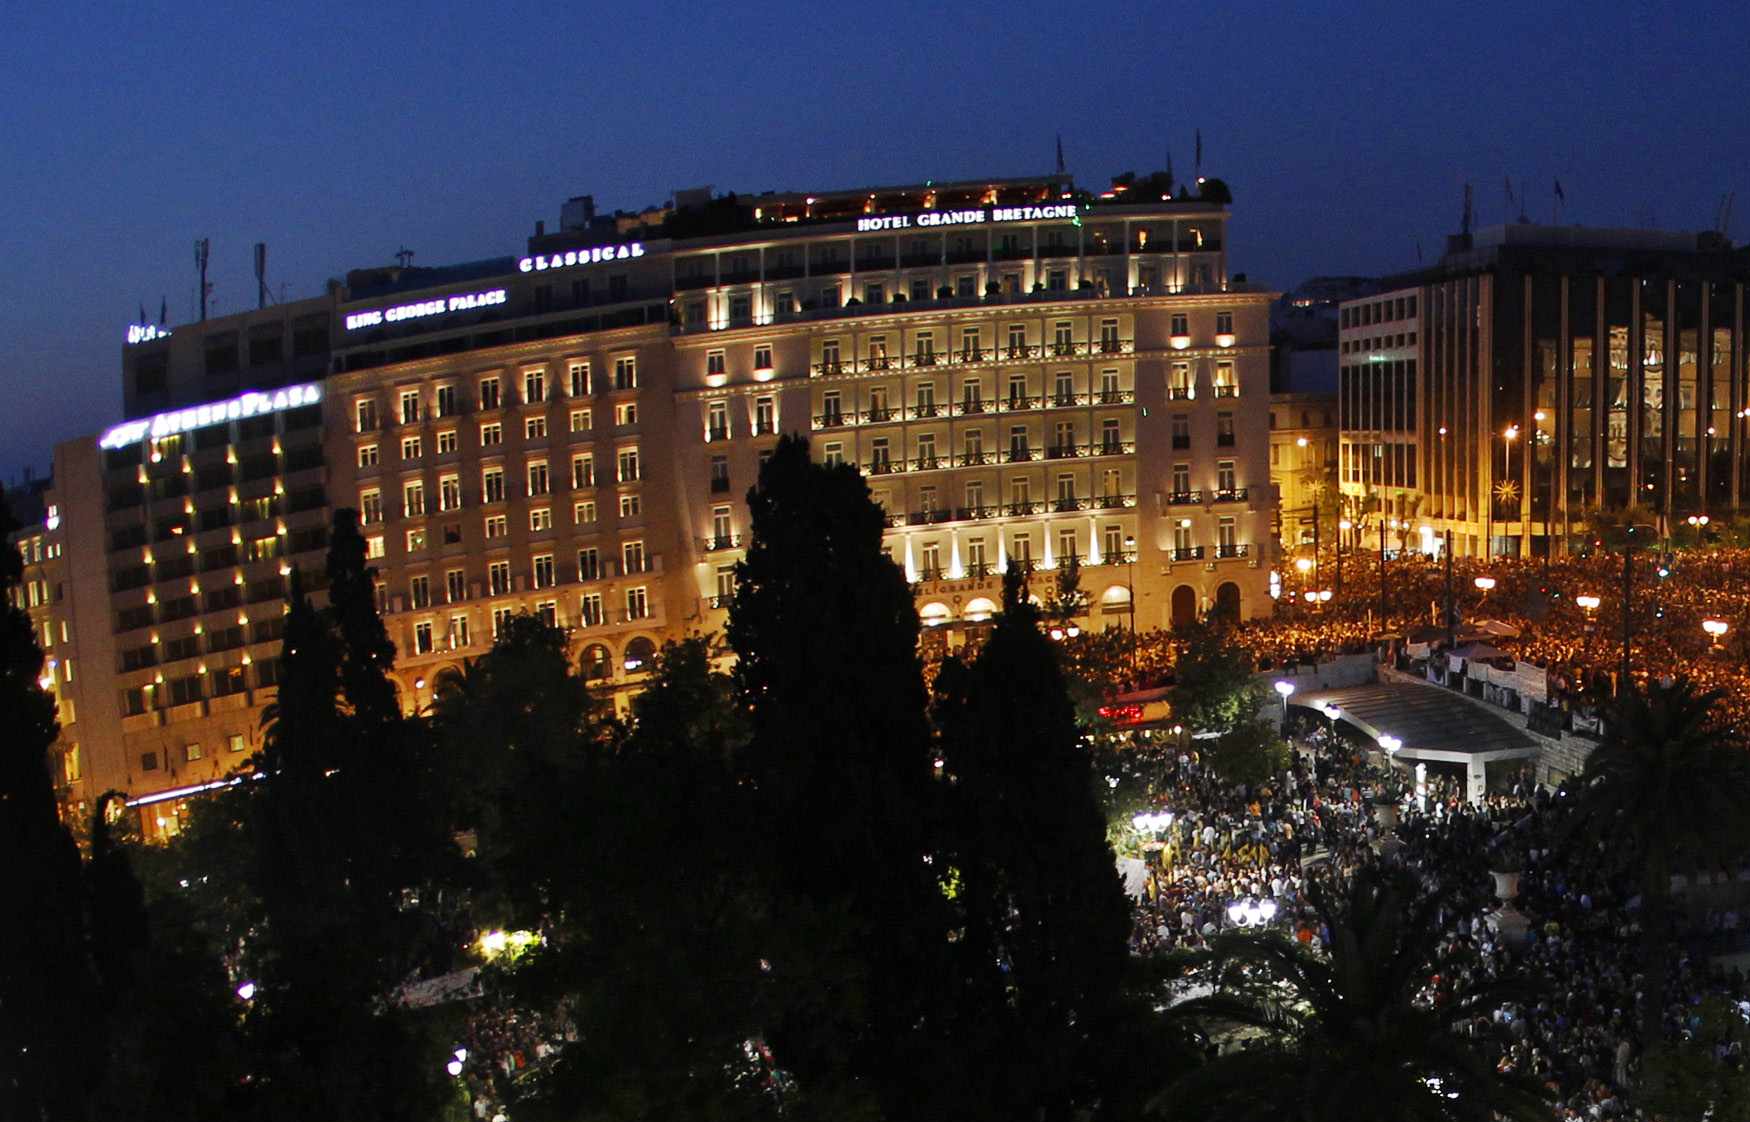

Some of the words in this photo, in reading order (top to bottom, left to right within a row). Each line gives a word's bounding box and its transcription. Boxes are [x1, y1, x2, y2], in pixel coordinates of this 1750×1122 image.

[858, 215, 911, 232] HOTEL
[917, 210, 985, 227] GRANDE
[993, 205, 1076, 222] BRETAGNE
[519, 243, 645, 272] CLASSICAL
[346, 311, 383, 330] KING
[385, 300, 446, 322] GEORGE
[449, 289, 507, 311] PALACE
[939, 582, 993, 594] GRANDE
